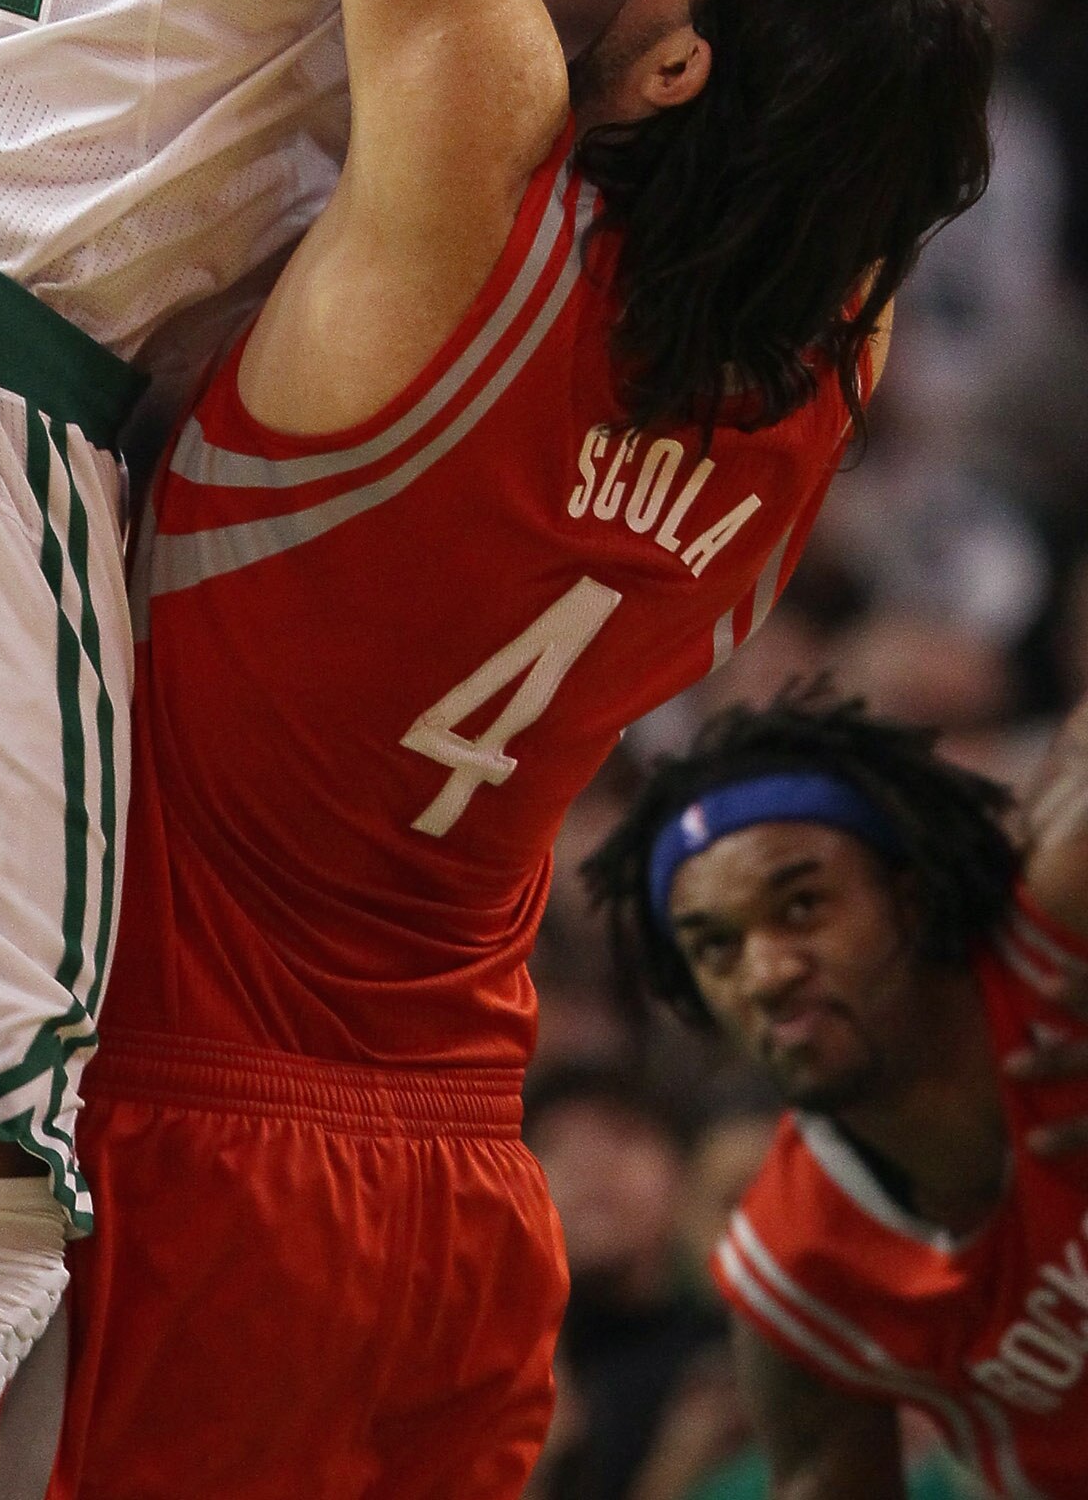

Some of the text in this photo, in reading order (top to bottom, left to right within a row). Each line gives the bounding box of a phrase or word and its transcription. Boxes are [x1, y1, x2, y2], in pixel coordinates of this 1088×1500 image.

[567, 423, 762, 578] SCOLA
[399, 575, 622, 838] 4
[970, 1212, 1088, 1412] ROCK
